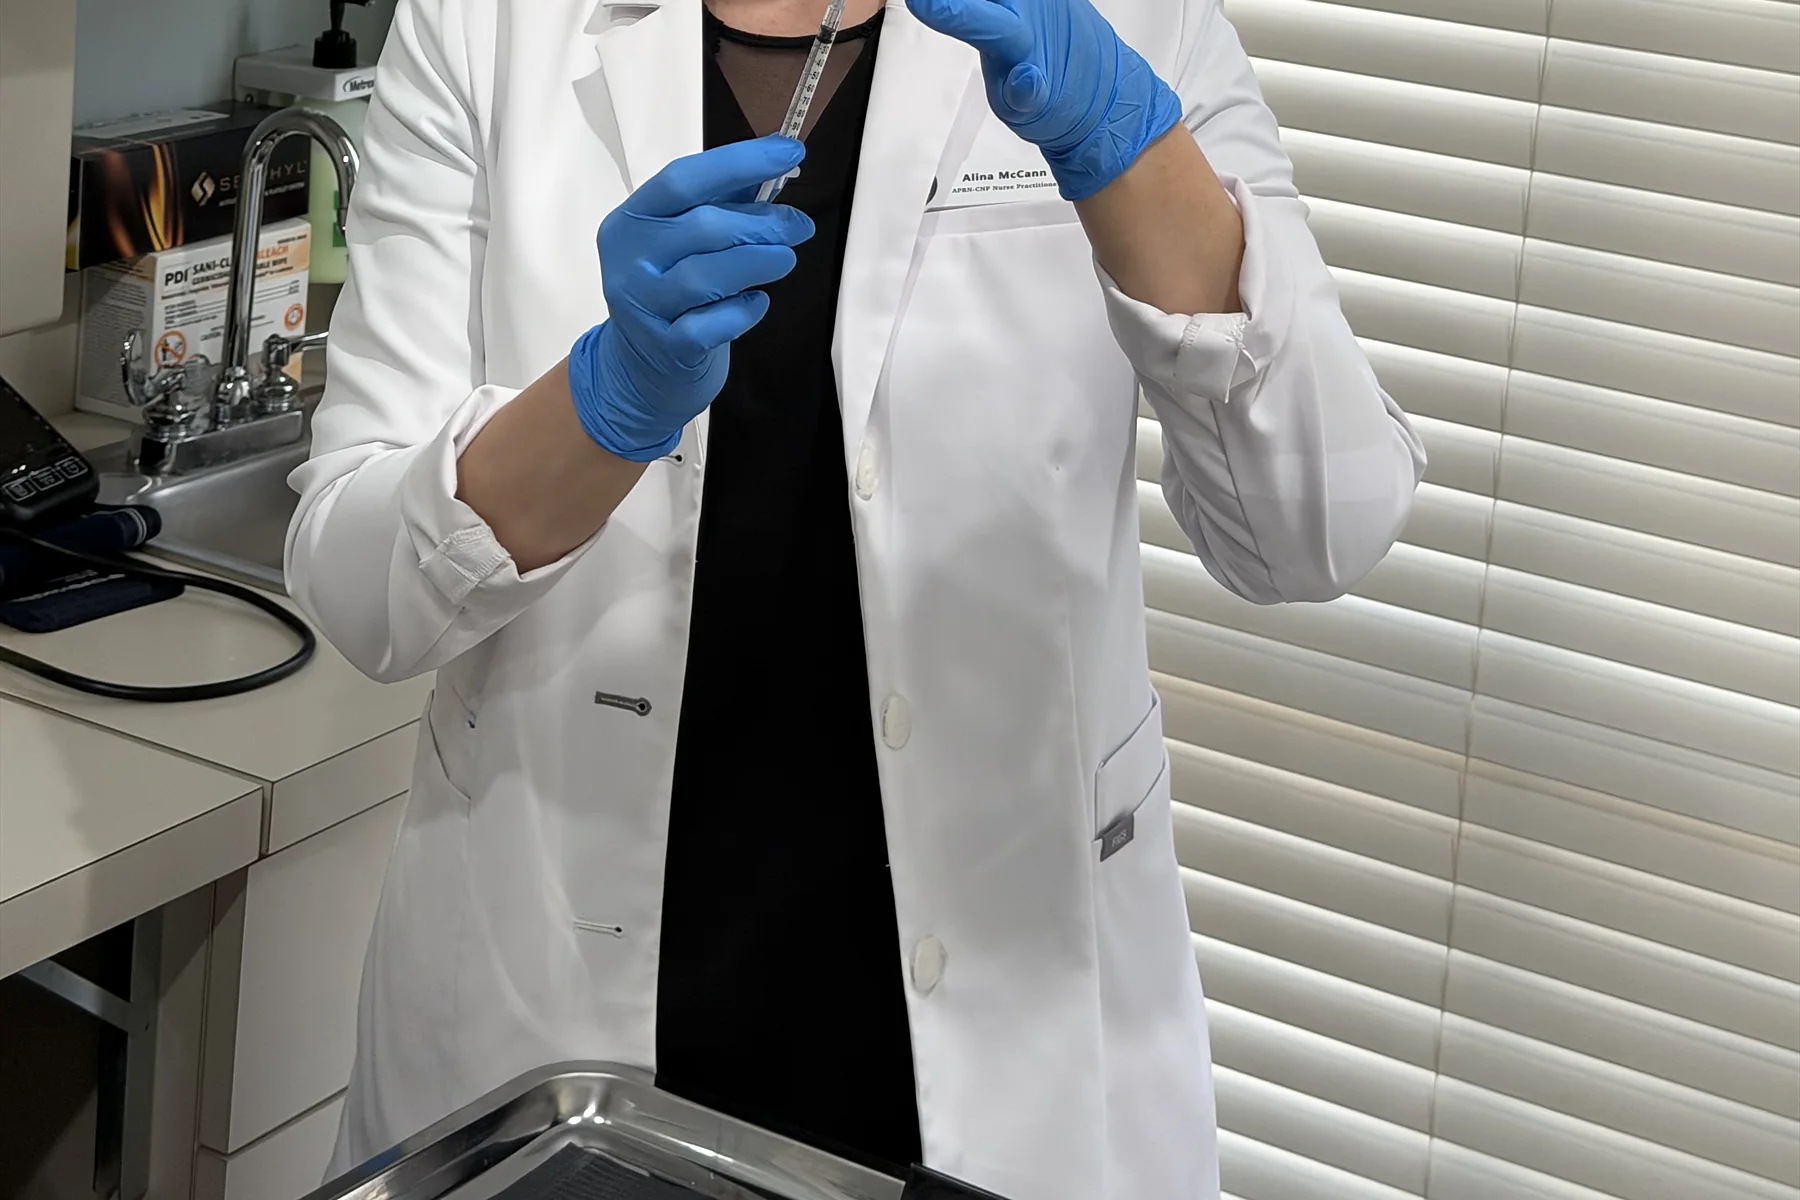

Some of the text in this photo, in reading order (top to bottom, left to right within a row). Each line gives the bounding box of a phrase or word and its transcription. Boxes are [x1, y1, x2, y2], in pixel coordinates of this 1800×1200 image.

[962, 170, 1047, 182] Alina McCann
[952, 186, 990, 194] APRN-CNP
[1016, 181, 1057, 189] Practitione
[192, 256, 231, 275] SANI-CL
[164, 267, 189, 286] PDI
